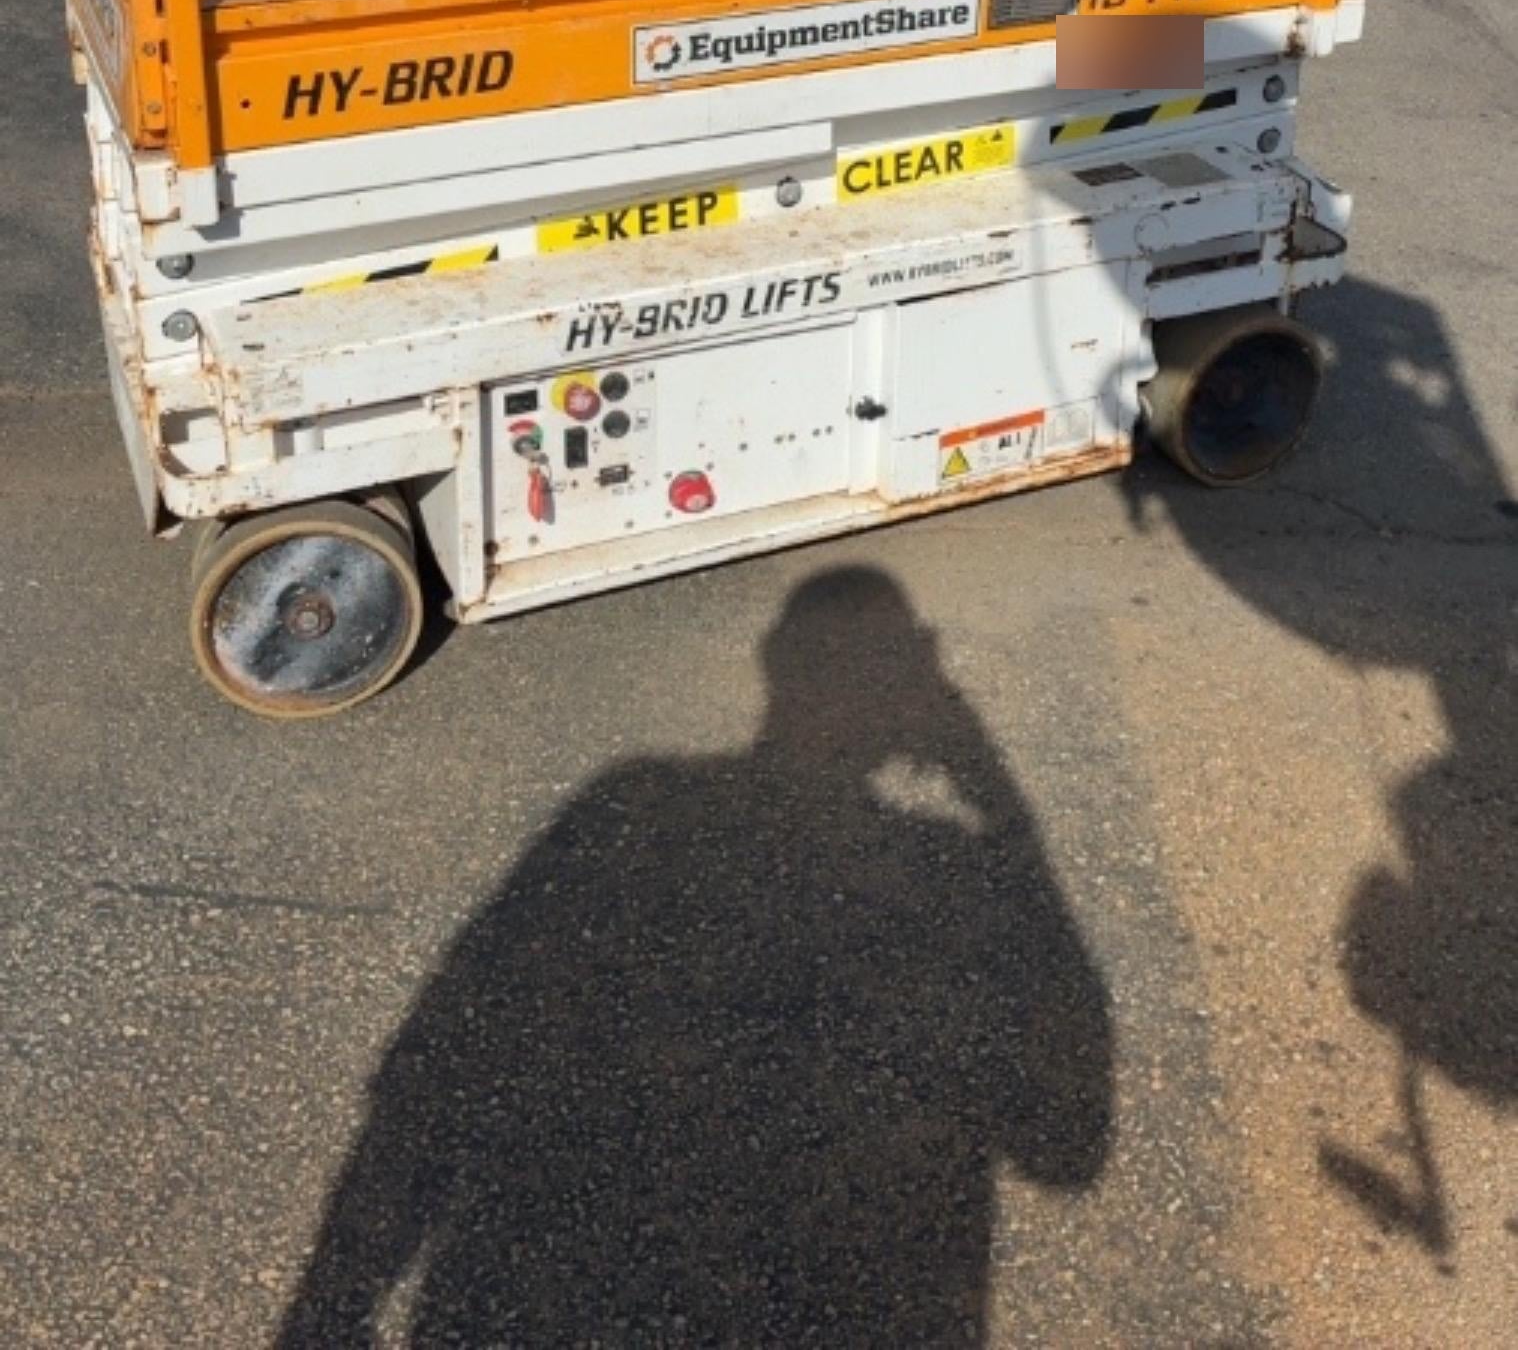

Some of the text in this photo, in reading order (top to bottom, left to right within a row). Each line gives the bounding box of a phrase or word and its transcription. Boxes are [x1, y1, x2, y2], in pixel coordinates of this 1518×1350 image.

[688, 3, 969, 63] EquipmentShare
[283, 50, 514, 120] HY-BRID
[605, 190, 719, 242] KEEP
[842, 139, 965, 194] CLEAR
[565, 271, 841, 352] HY-BRID LIFTS
